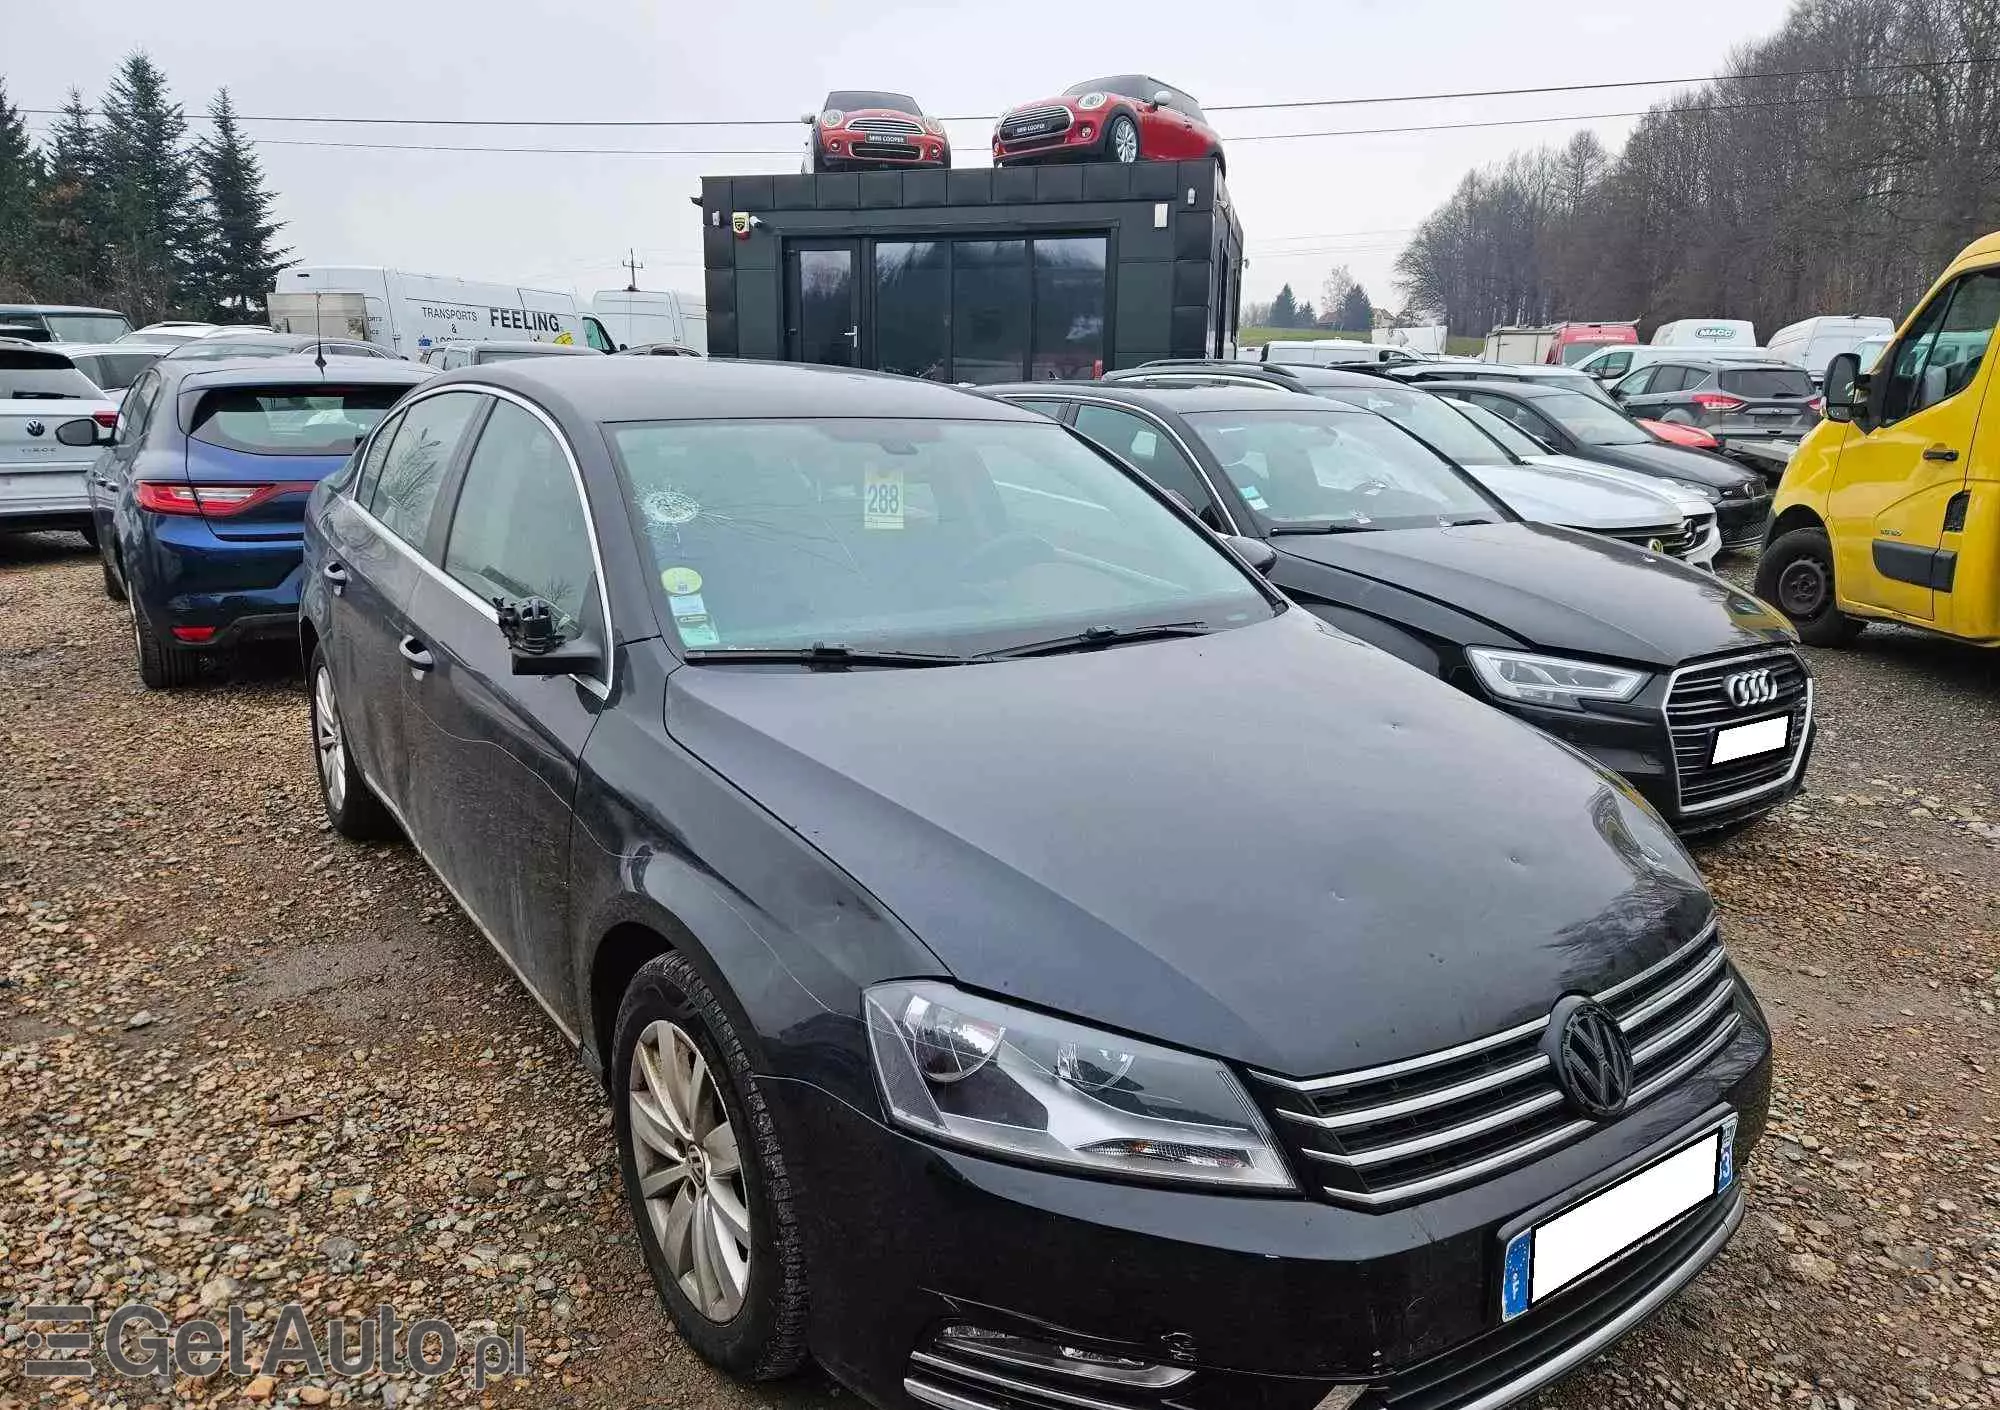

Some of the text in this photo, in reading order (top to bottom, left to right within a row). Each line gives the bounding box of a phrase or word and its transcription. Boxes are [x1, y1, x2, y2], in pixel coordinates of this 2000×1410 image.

[421, 307, 479, 321] TRANSPORTS
[490, 307, 560, 333] FEELING
[451, 323, 457, 333] &
[868, 484, 899, 513] 288
